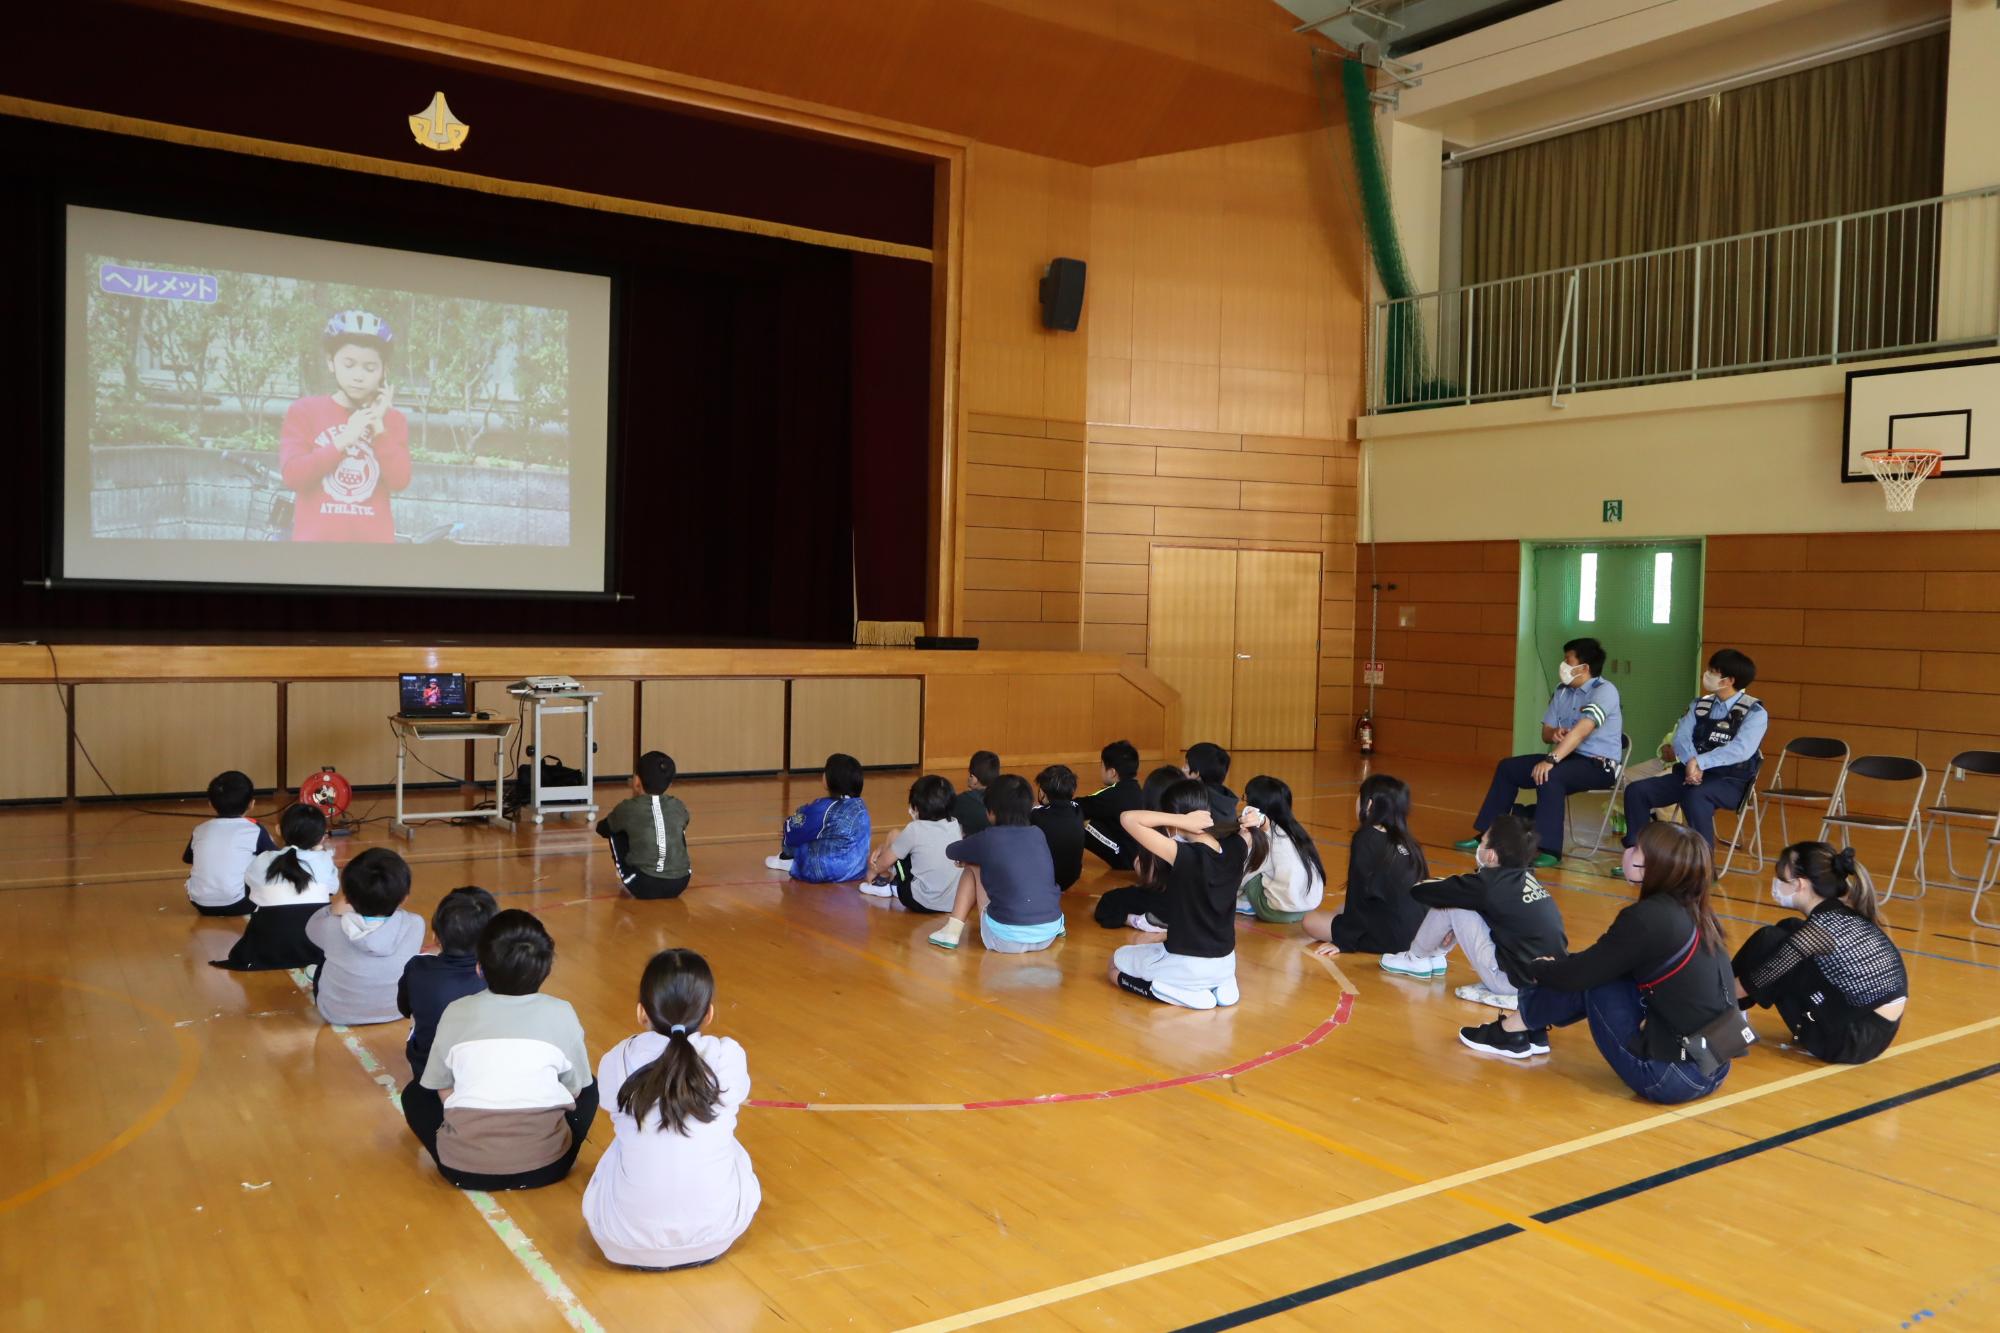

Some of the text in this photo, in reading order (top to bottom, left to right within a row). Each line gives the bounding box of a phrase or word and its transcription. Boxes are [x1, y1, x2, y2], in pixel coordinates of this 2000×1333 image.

[104, 271, 213, 299] ヘルメット
